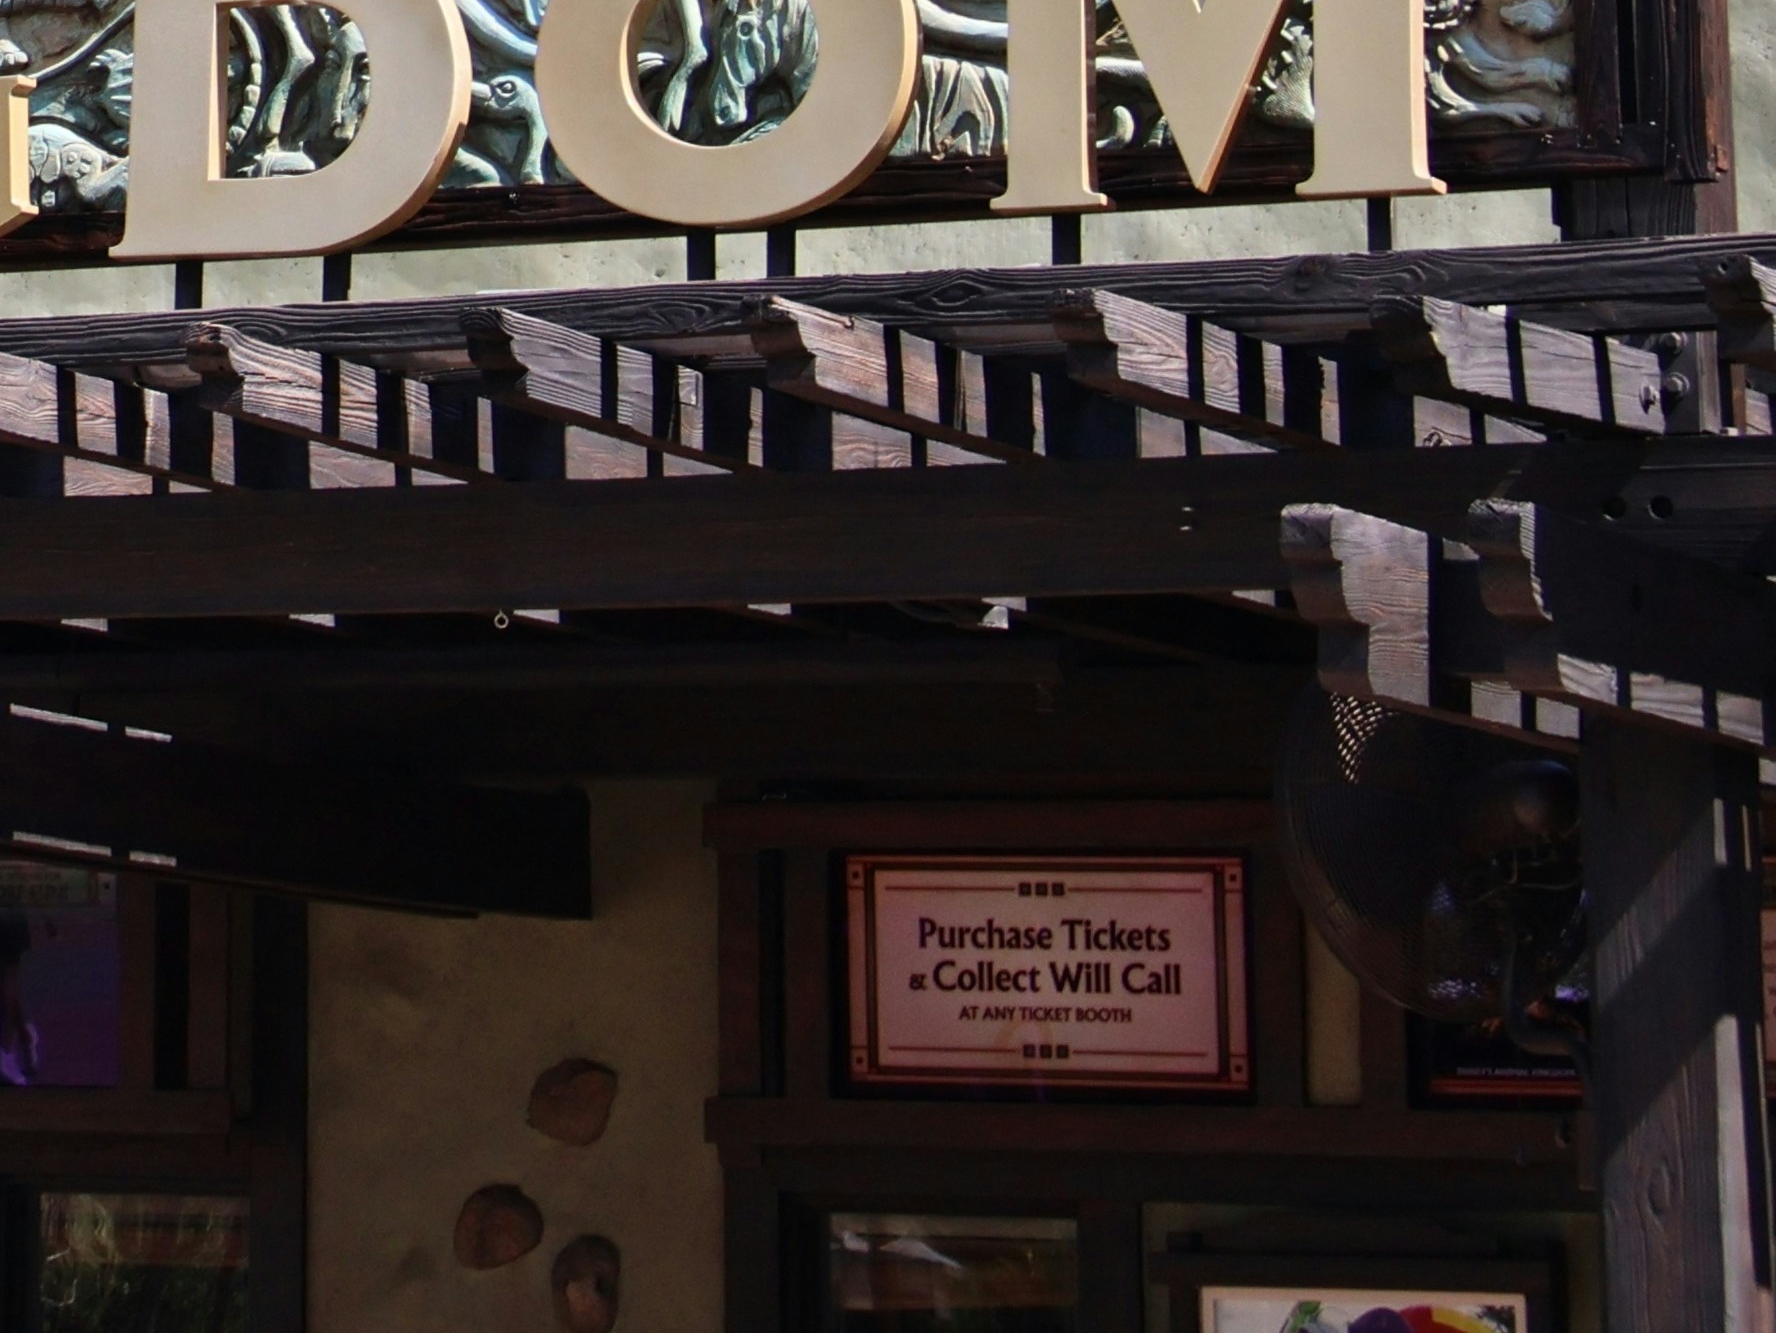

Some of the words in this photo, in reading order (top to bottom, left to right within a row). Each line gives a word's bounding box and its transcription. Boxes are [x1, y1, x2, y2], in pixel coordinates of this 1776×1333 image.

[918, 918, 1052, 951] Purchase
[1061, 919, 1171, 951] Tickets
[909, 973, 927, 991] &
[933, 961, 1040, 993] Collect
[1049, 962, 1111, 994] Will
[1122, 964, 1181, 995] Call
[959, 1006, 980, 1021] AT
[983, 1006, 1016, 1021] ANY
[1018, 1007, 1072, 1023] TICKET
[1075, 1008, 1132, 1023] BOOTH
